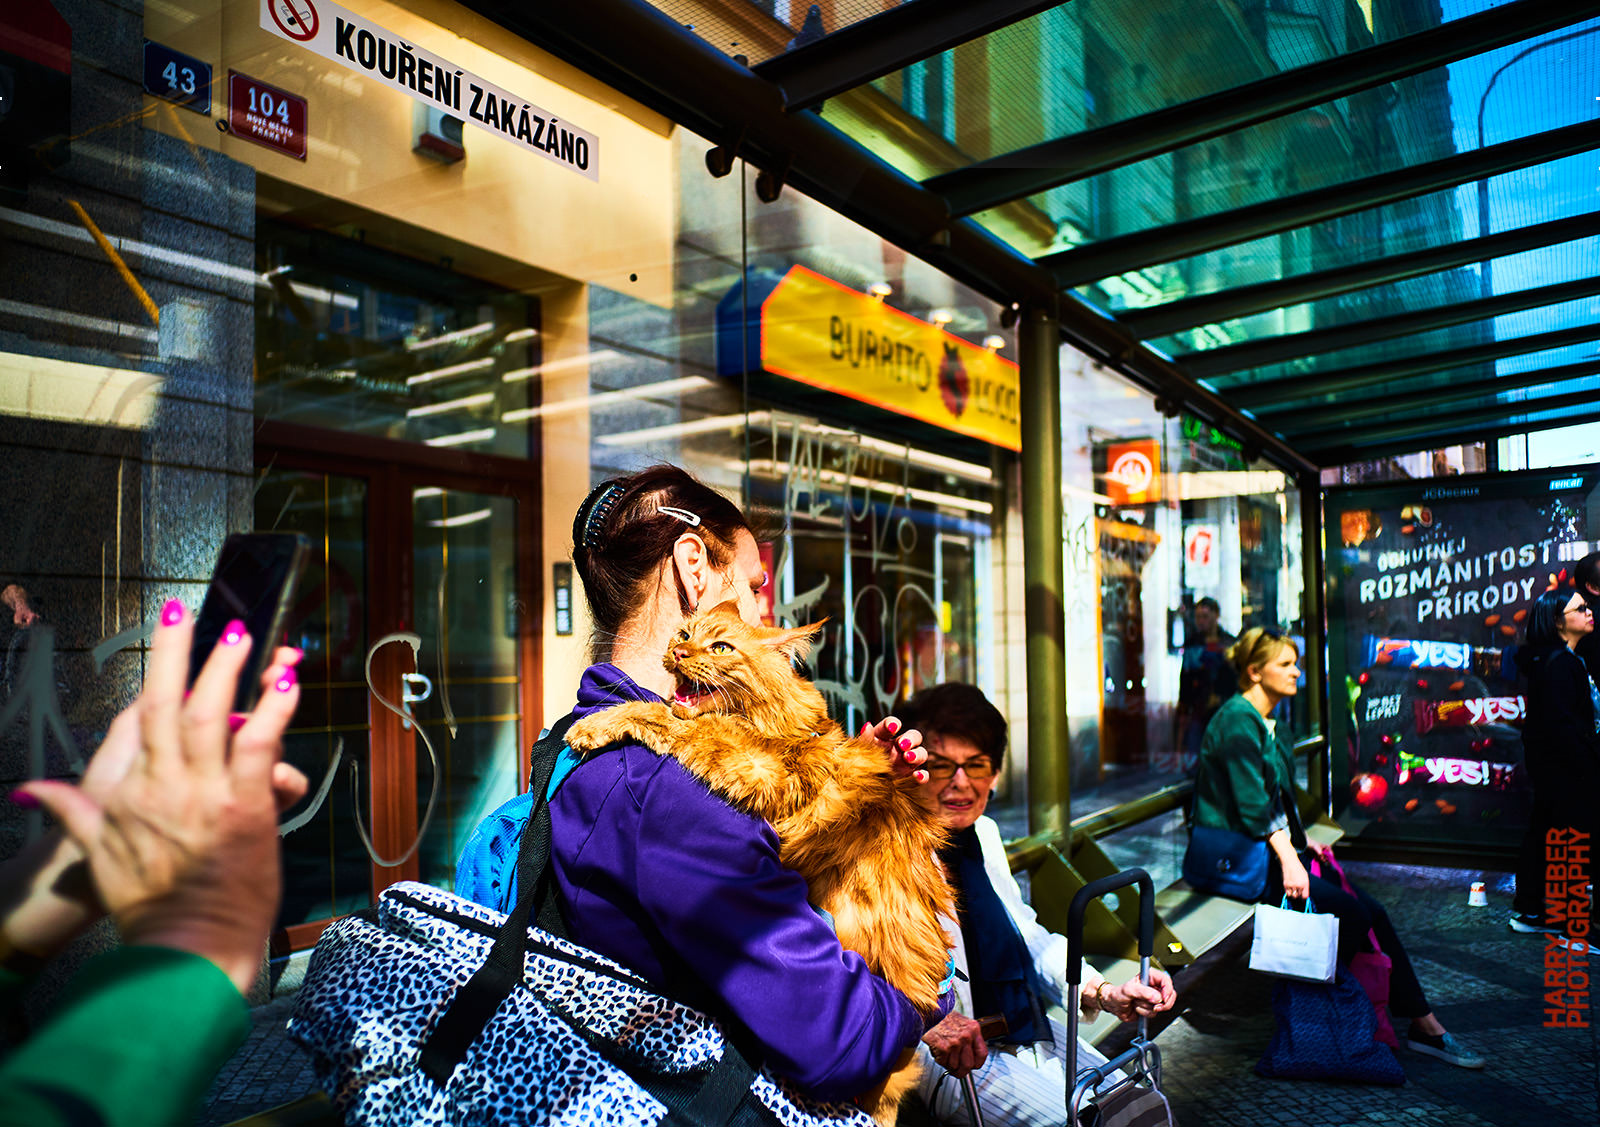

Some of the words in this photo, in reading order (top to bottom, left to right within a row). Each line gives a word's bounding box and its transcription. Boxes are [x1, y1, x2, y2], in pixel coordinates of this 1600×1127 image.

[163, 61, 195, 95] 43
[335, 17, 463, 112] KOUŘENÍ
[469, 83, 590, 171] ZAKÁZÁNO
[249, 87, 289, 124] 104
[252, 125, 280, 143] PRAHA
[830, 316, 931, 392] BURRITO
[1417, 576, 1536, 624] PŘÍRODY
[1411, 640, 1470, 669] YES!
[1464, 695, 1526, 725] YES!
[1424, 757, 1491, 786] YES!
